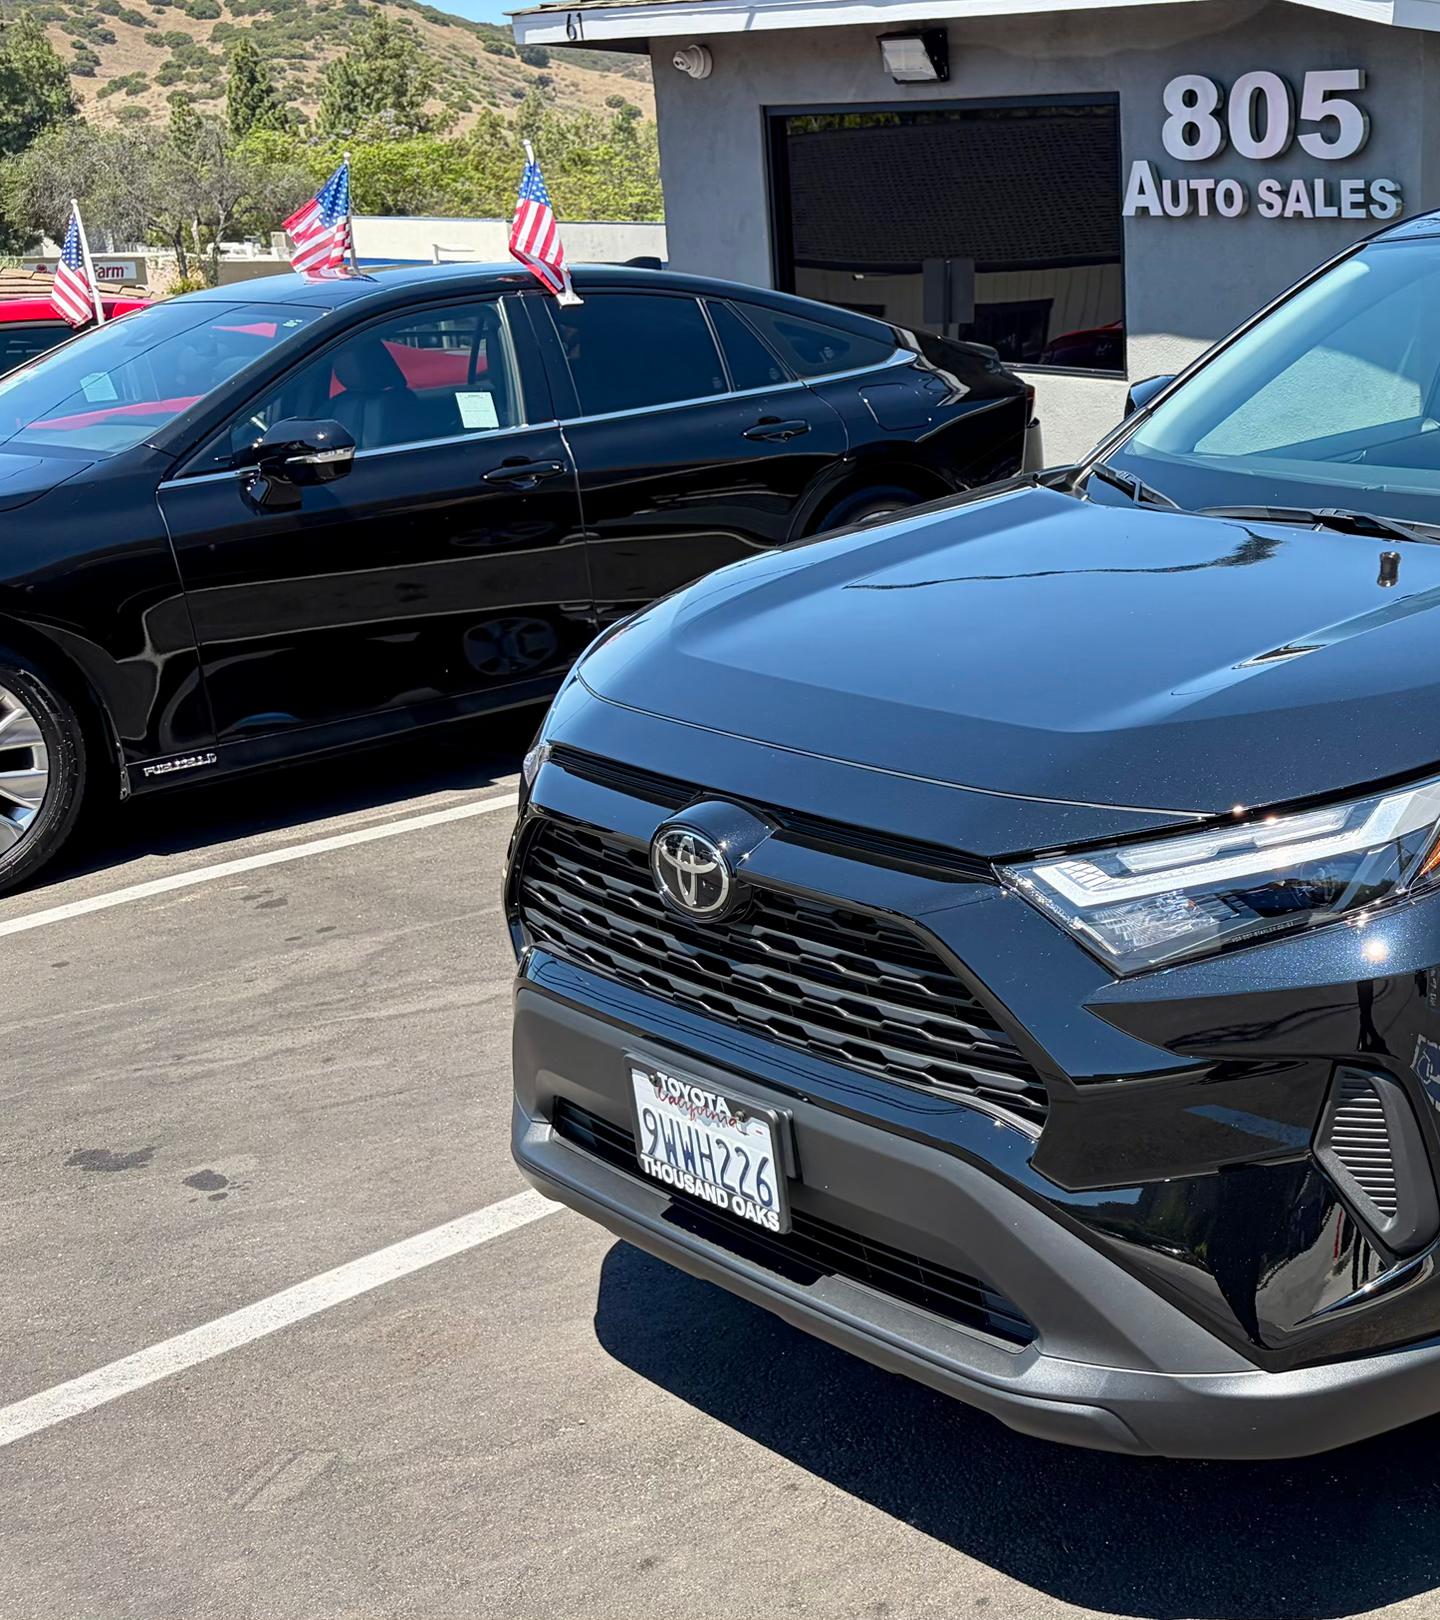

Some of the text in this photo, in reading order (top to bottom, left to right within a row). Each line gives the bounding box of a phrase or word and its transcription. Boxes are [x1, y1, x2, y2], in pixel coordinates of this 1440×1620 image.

[566, 12, 584, 41] 61
[1162, 69, 1370, 161] 805
[1122, 160, 1402, 219] AUTO SALES
[656, 1072, 732, 1117] TOYOTA
[642, 1107, 774, 1208] 9WWH226
[640, 1154, 780, 1233] THOUSAND OAKS
